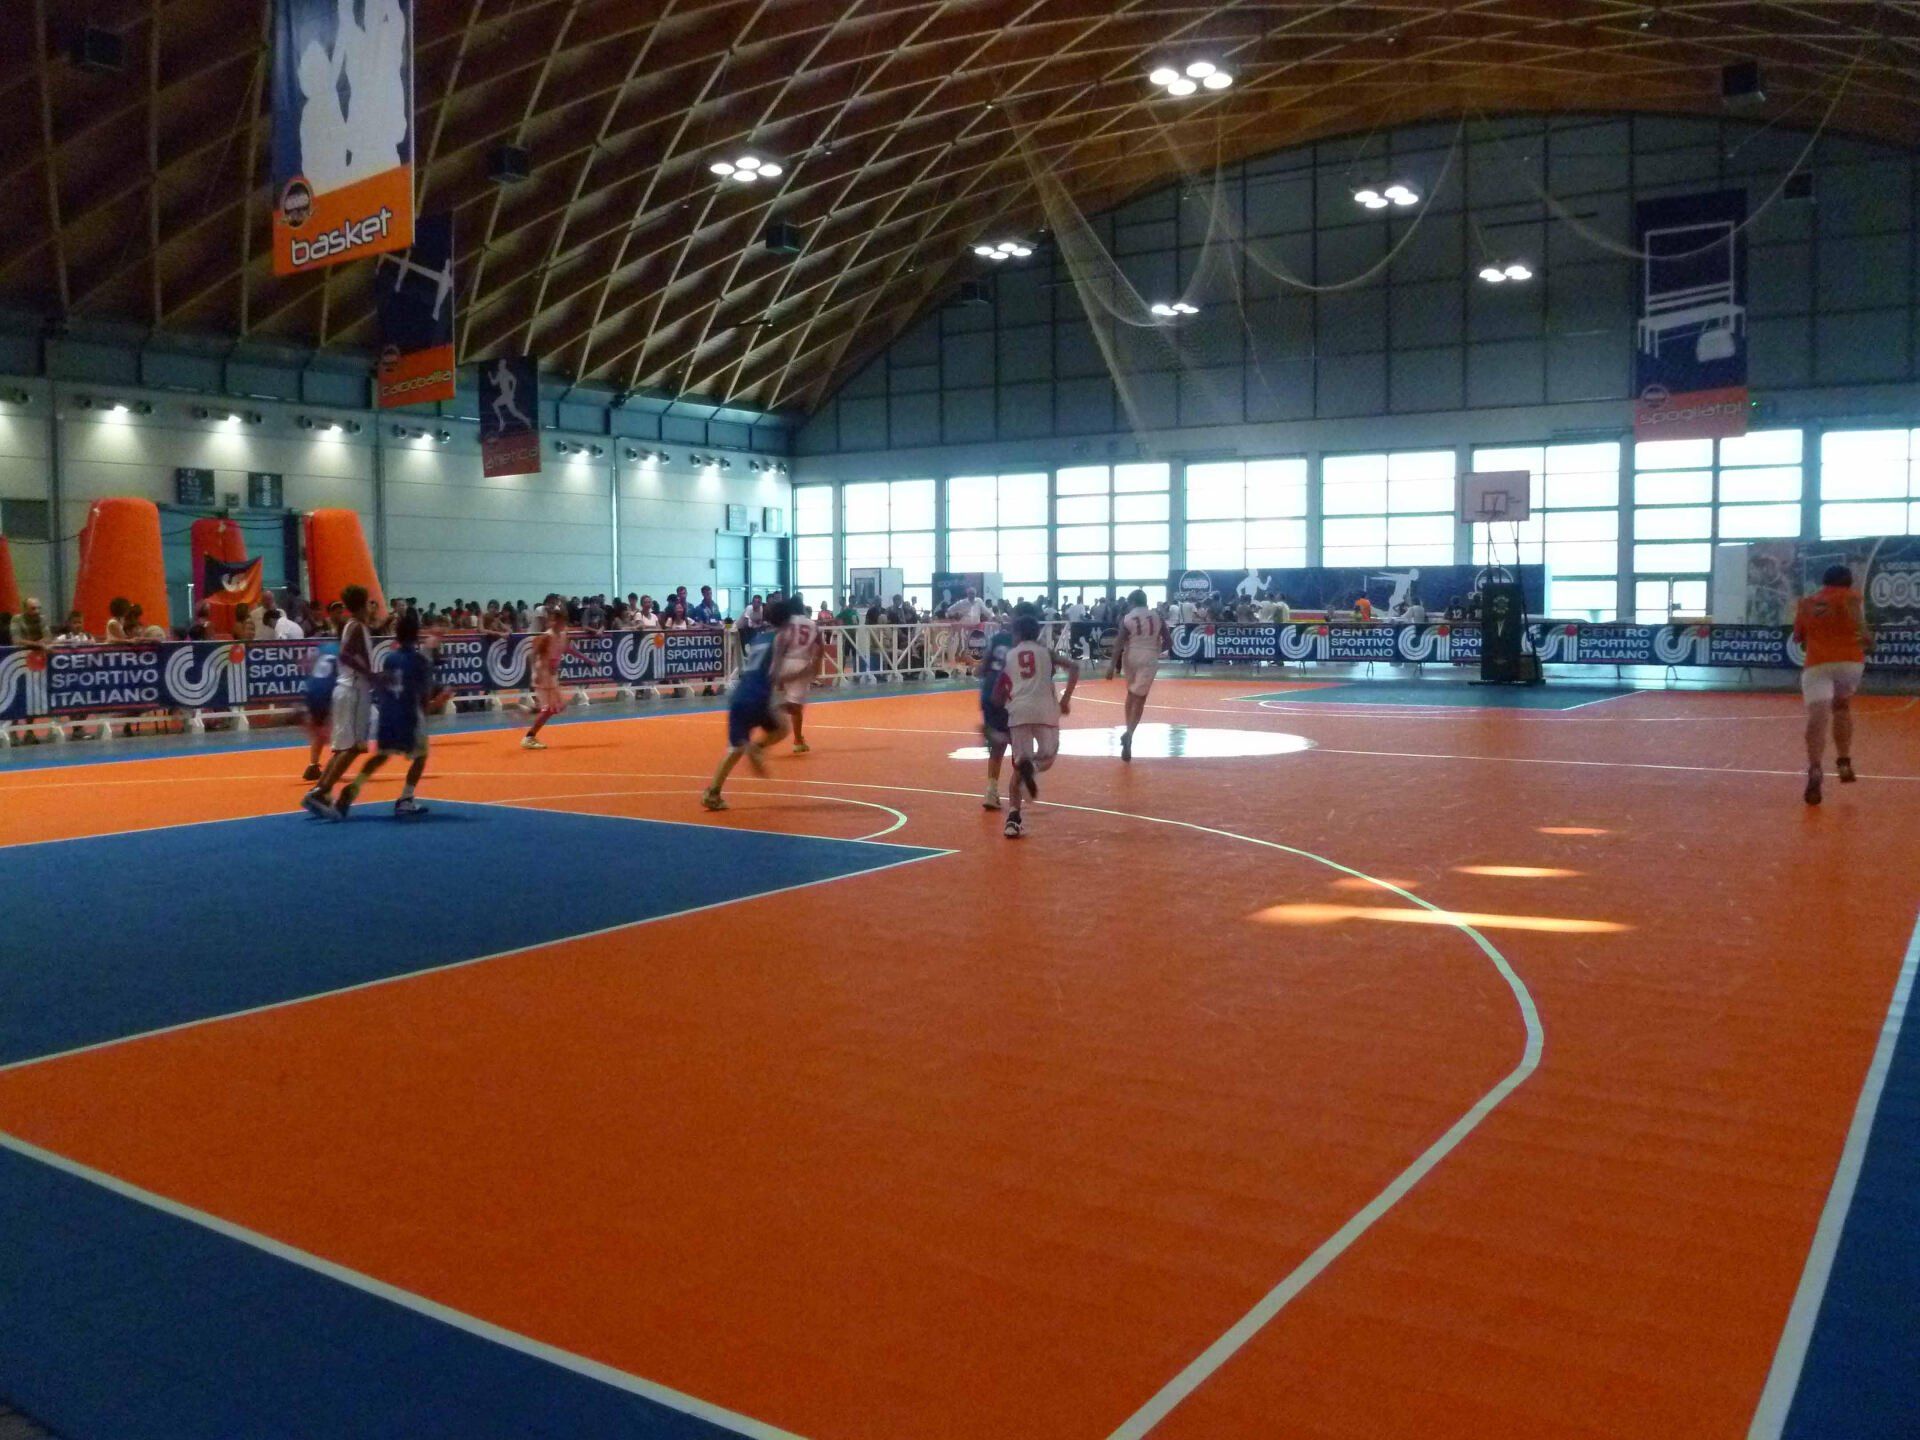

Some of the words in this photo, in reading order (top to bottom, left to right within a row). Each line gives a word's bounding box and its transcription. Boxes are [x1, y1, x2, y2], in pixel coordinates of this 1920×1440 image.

[291, 207, 392, 266] basket
[1132, 616, 1154, 636] 11
[1217, 627, 1276, 636] CENTRO
[1331, 628, 1394, 637] CENTRO
[1579, 628, 1650, 638] CENTRO
[1711, 629, 1783, 639] CENTRO
[666, 635, 723, 647] CENTRO
[1217, 637, 1276, 646] SPORTIVO
[1331, 638, 1394, 647] SPORTIVO
[1579, 638, 1650, 648] SPORTIVO
[1711, 640, 1783, 651] SPORTIVO
[666, 648, 723, 660] SPORTIVO
[1217, 647, 1276, 656] ITALIANO
[1331, 648, 1394, 657] ITALIANO
[1579, 649, 1650, 659] ITALIANO
[1711, 651, 1783, 662] ITALIANO
[51, 651, 158, 670] CENTRO
[1018, 651, 1036, 680] 9
[666, 660, 723, 673] ITALIANO
[51, 669, 158, 688] SPORTIVO
[51, 687, 158, 707] ITALIANO
